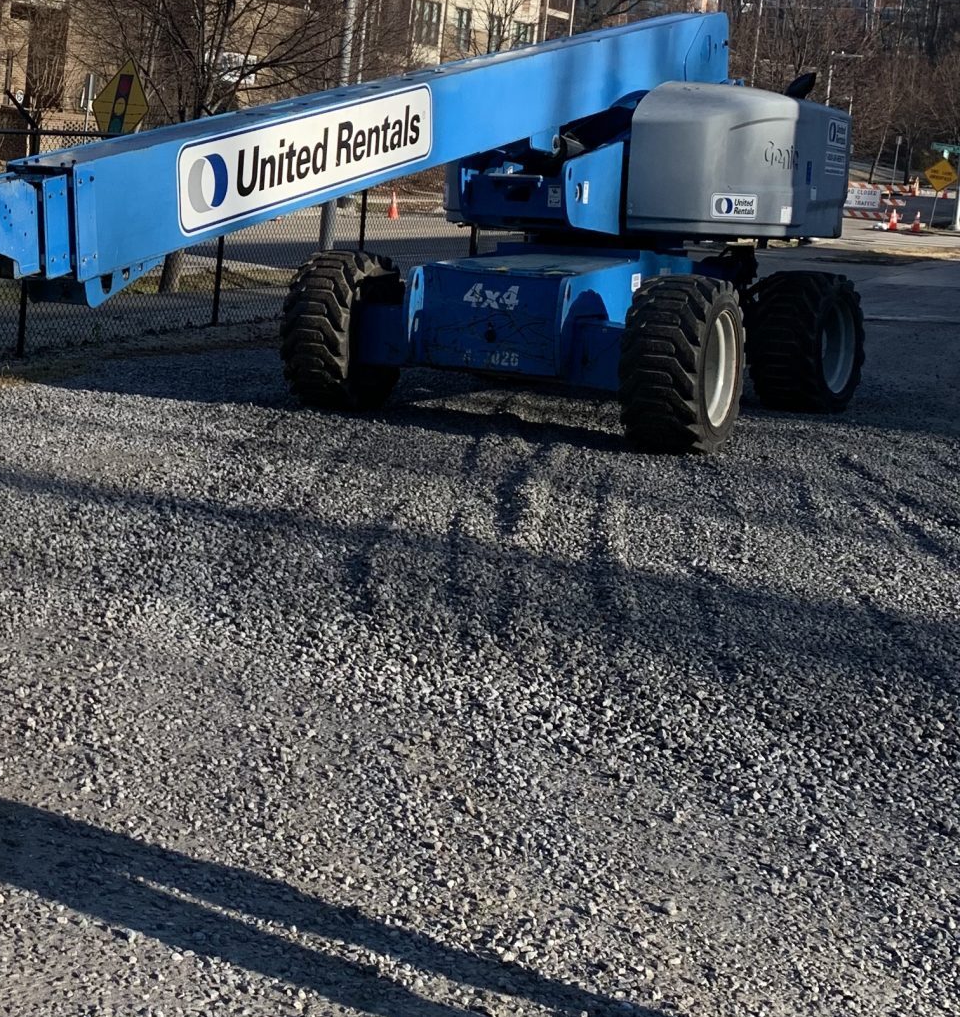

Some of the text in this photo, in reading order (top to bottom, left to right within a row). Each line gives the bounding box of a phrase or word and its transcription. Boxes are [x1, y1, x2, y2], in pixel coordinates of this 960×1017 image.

[237, 105, 420, 197] United Rentals
[734, 207, 754, 215] Rentals
[735, 199, 754, 207] United
[463, 283, 520, 311] 4x4
